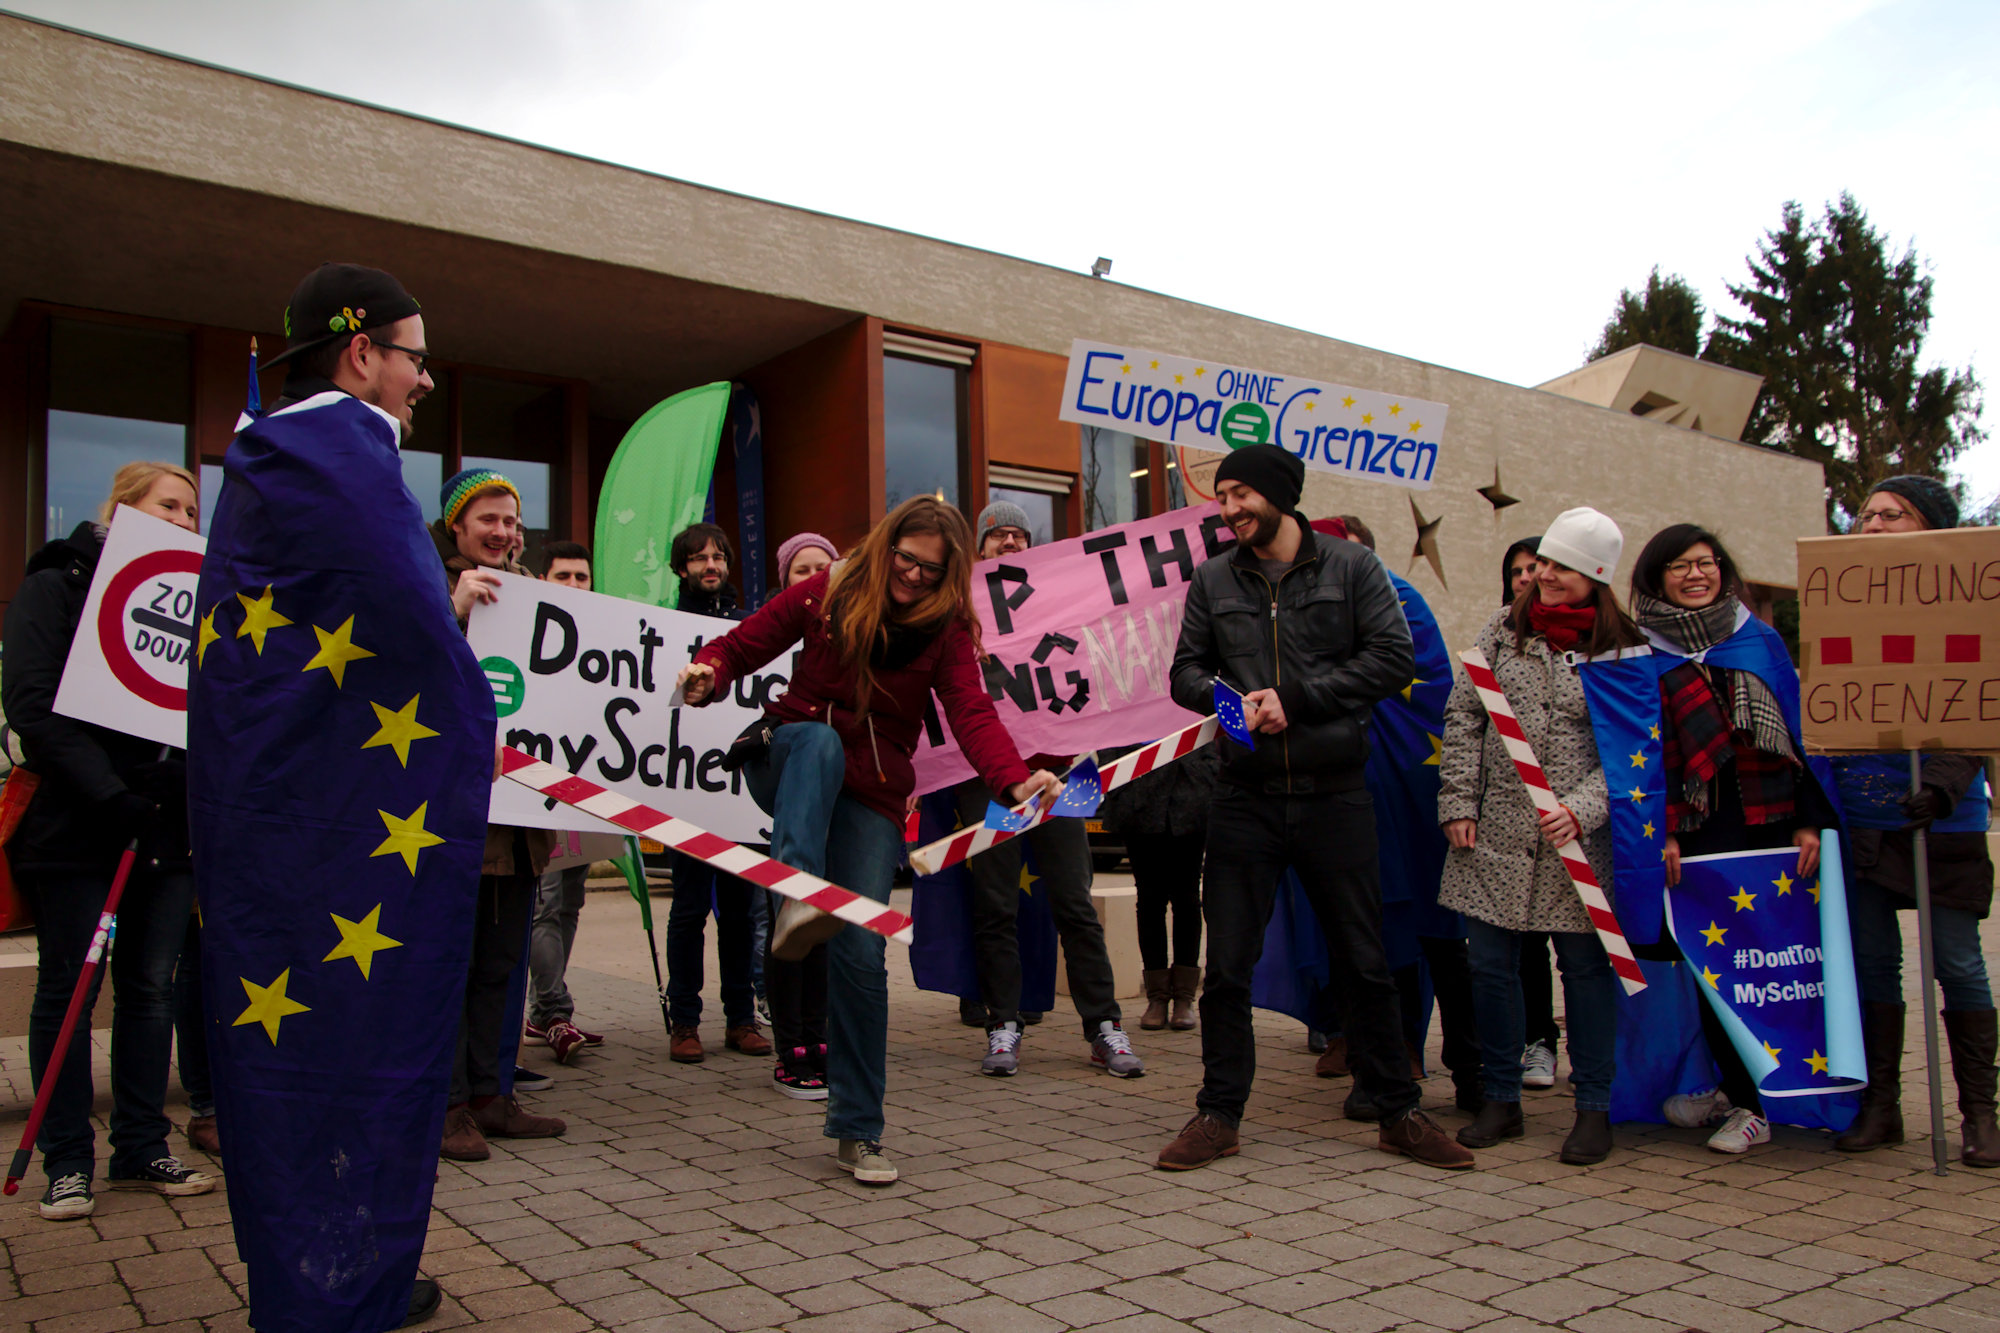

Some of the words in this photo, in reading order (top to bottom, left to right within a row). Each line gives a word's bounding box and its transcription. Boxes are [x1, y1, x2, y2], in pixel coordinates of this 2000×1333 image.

[1076, 351, 1223, 441] Europa
[1217, 369, 1284, 406] OHNE
[1275, 388, 1438, 481] Grenzen
[1805, 560, 2000, 606] ACHTUNG
[529, 601, 664, 693] Don't
[1807, 678, 2000, 724] GRENZE
